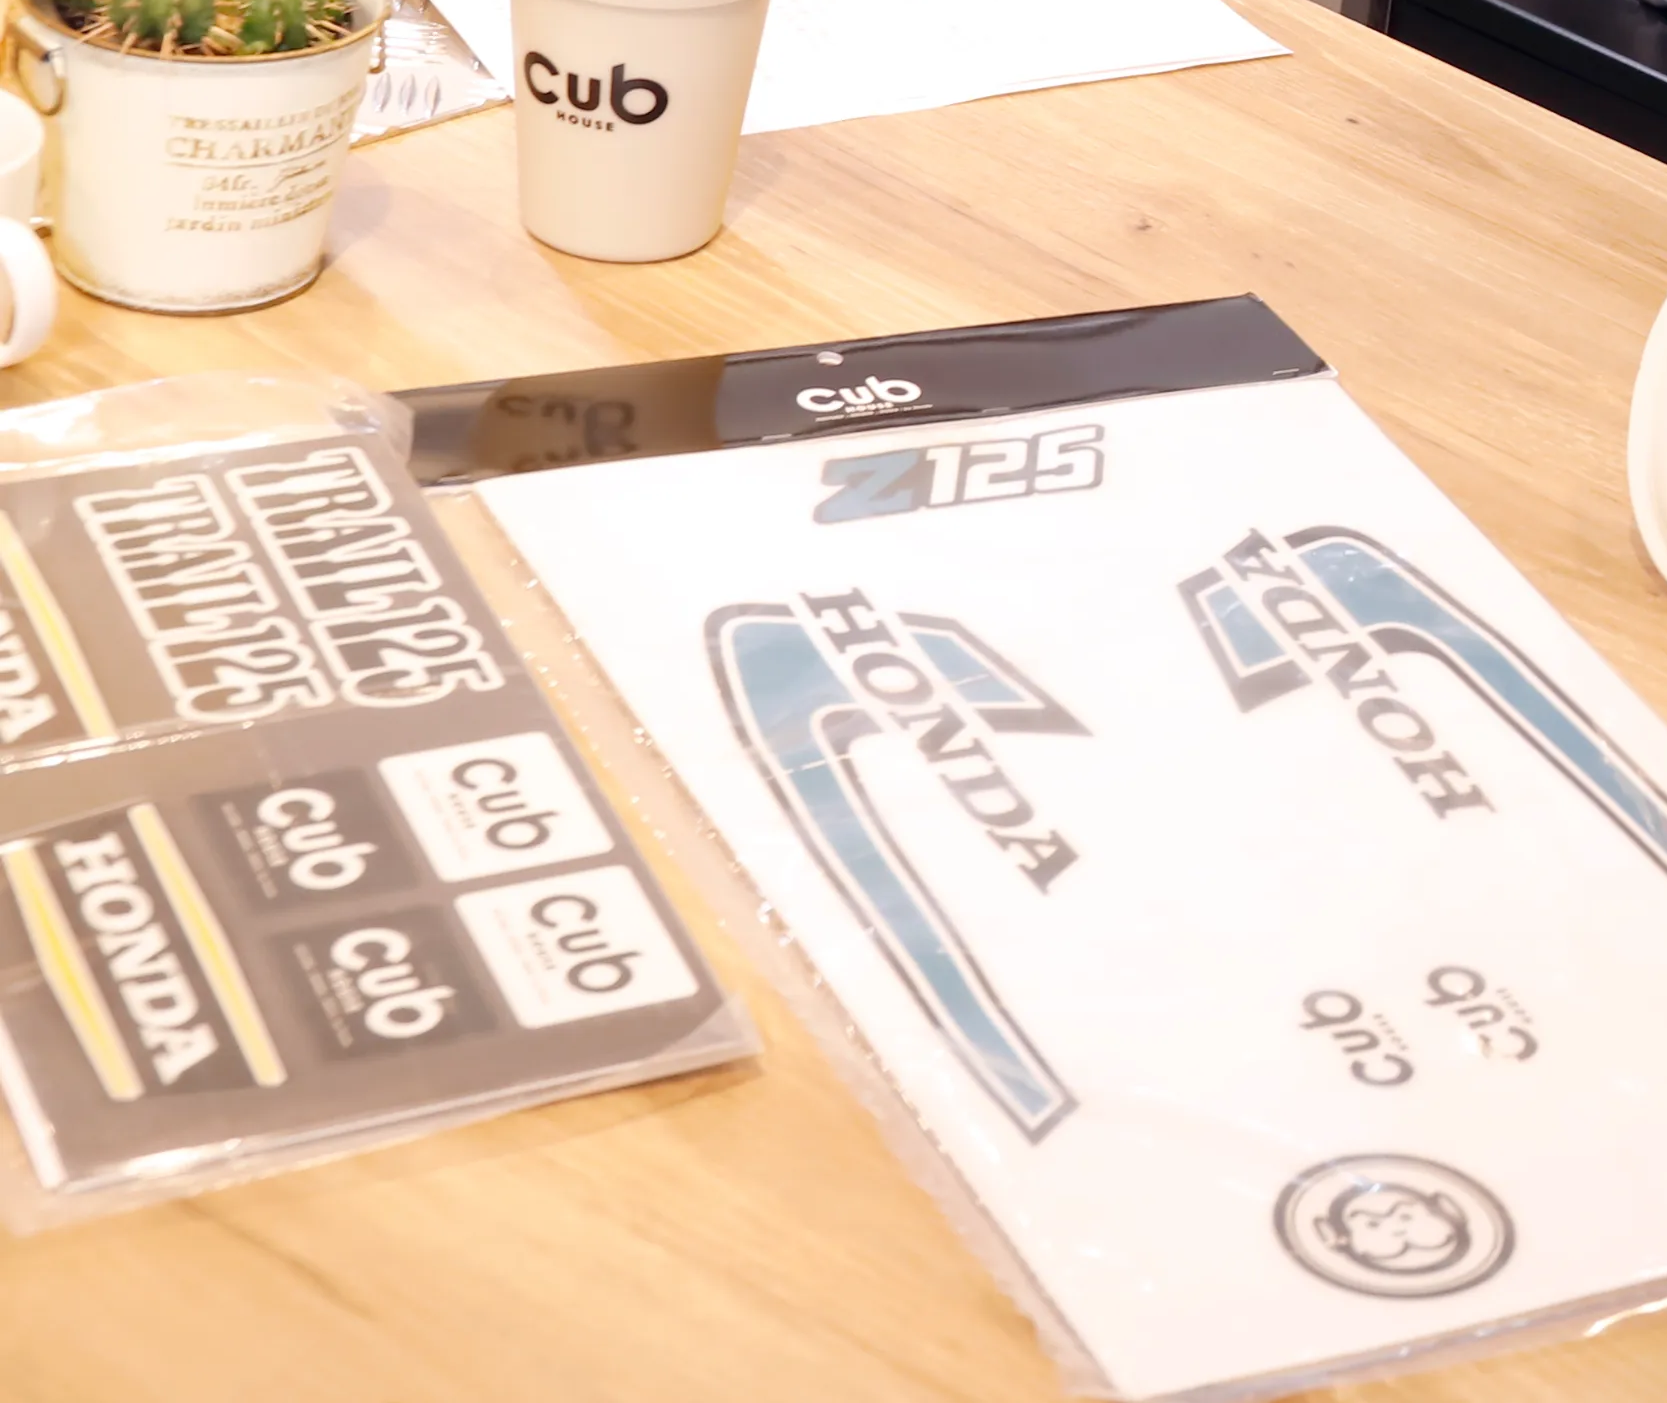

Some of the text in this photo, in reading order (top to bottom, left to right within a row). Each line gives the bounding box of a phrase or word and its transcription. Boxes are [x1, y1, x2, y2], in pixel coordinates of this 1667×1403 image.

[523, 50, 670, 126] Cub
[556, 110, 616, 133] HOUSE
[795, 375, 922, 413] Cub
[812, 424, 1106, 525] Z125
[1222, 527, 1498, 821] HONDA
[799, 586, 1081, 896] HONDA
[256, 787, 379, 891] Cub
[452, 758, 560, 851] Cub
[53, 831, 219, 1087] HONDA
[330, 927, 457, 1040] Cub
[530, 894, 641, 993] Cub
[1299, 989, 1414, 1087] Cub
